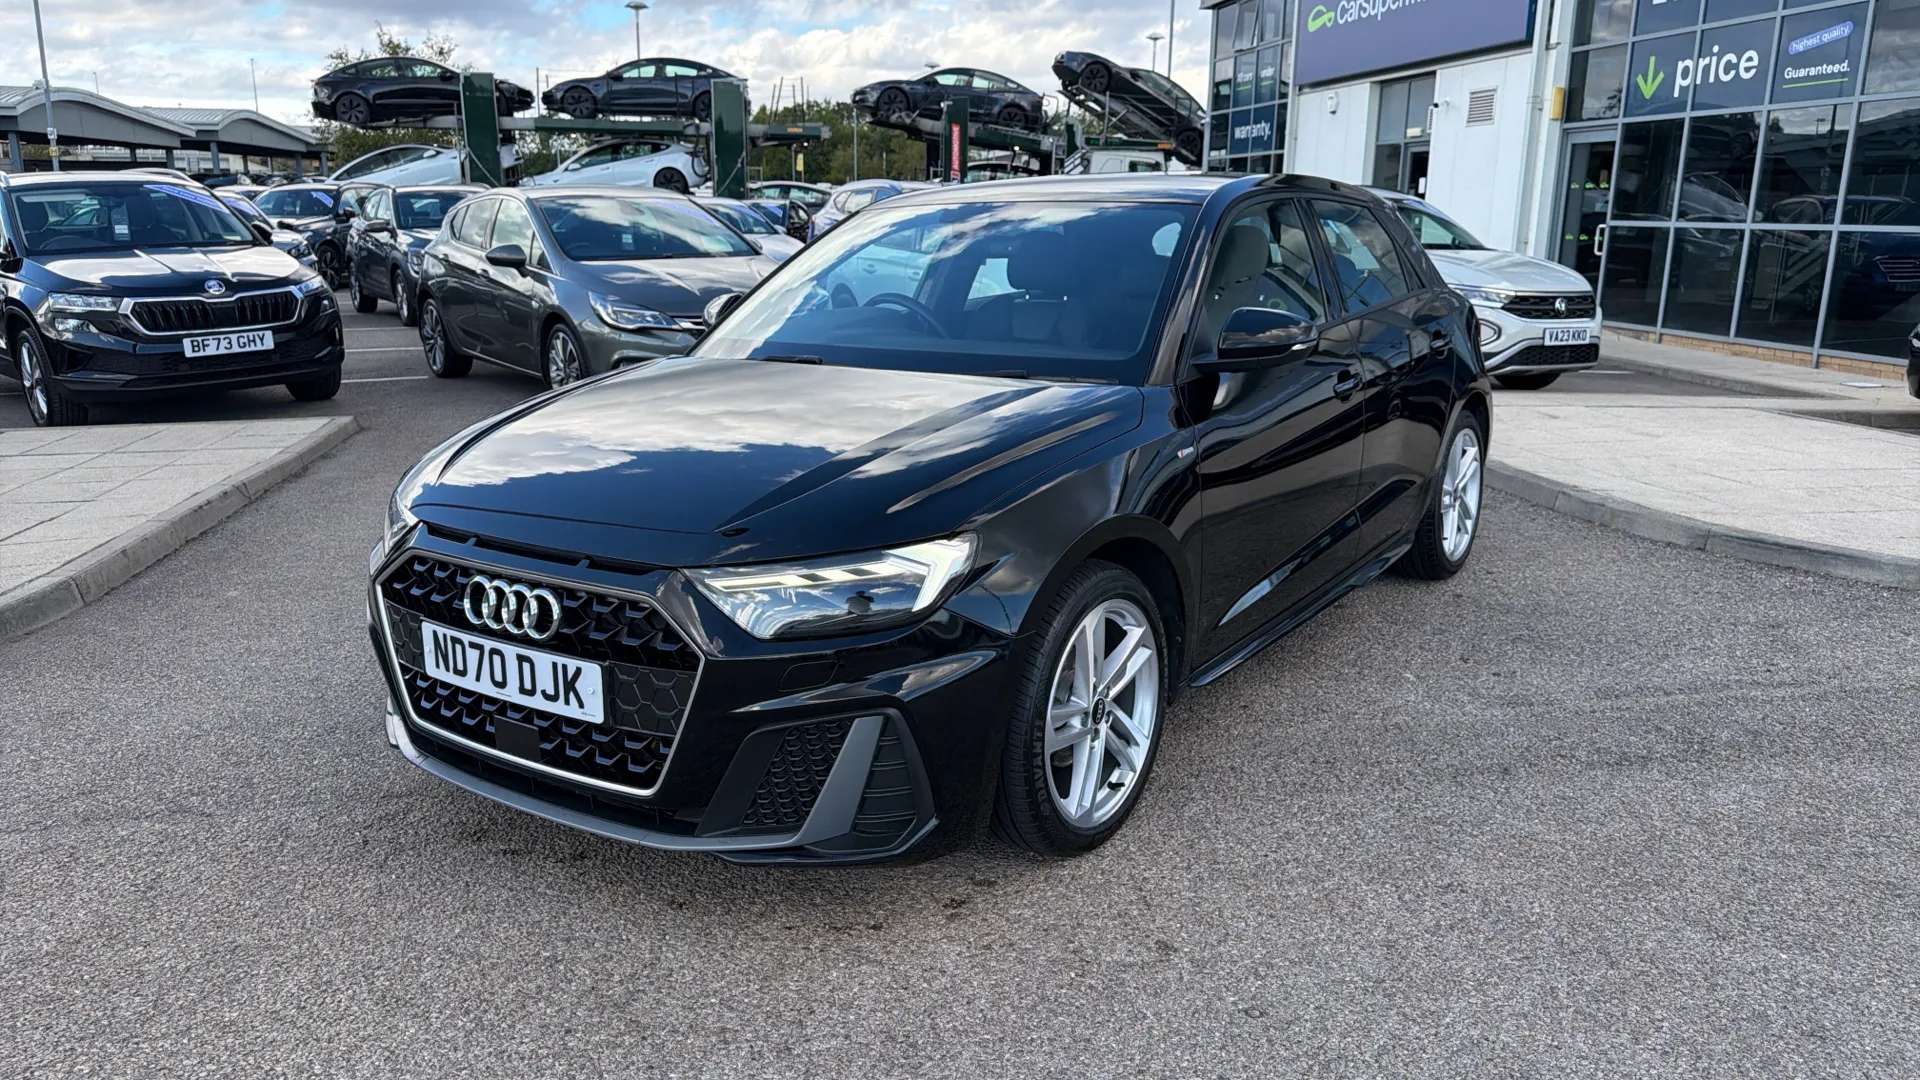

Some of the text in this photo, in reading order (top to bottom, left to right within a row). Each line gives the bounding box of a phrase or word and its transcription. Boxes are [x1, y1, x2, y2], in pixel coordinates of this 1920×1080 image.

[1792, 35, 1821, 52] highest
[1673, 45, 1759, 98] price
[1784, 59, 1851, 79] Guaranteed.
[1234, 120, 1271, 141] warranty.
[190, 333, 265, 353] BF73 GHY
[1549, 329, 1570, 342] VA23
[432, 629, 585, 710] ND70 DJK
